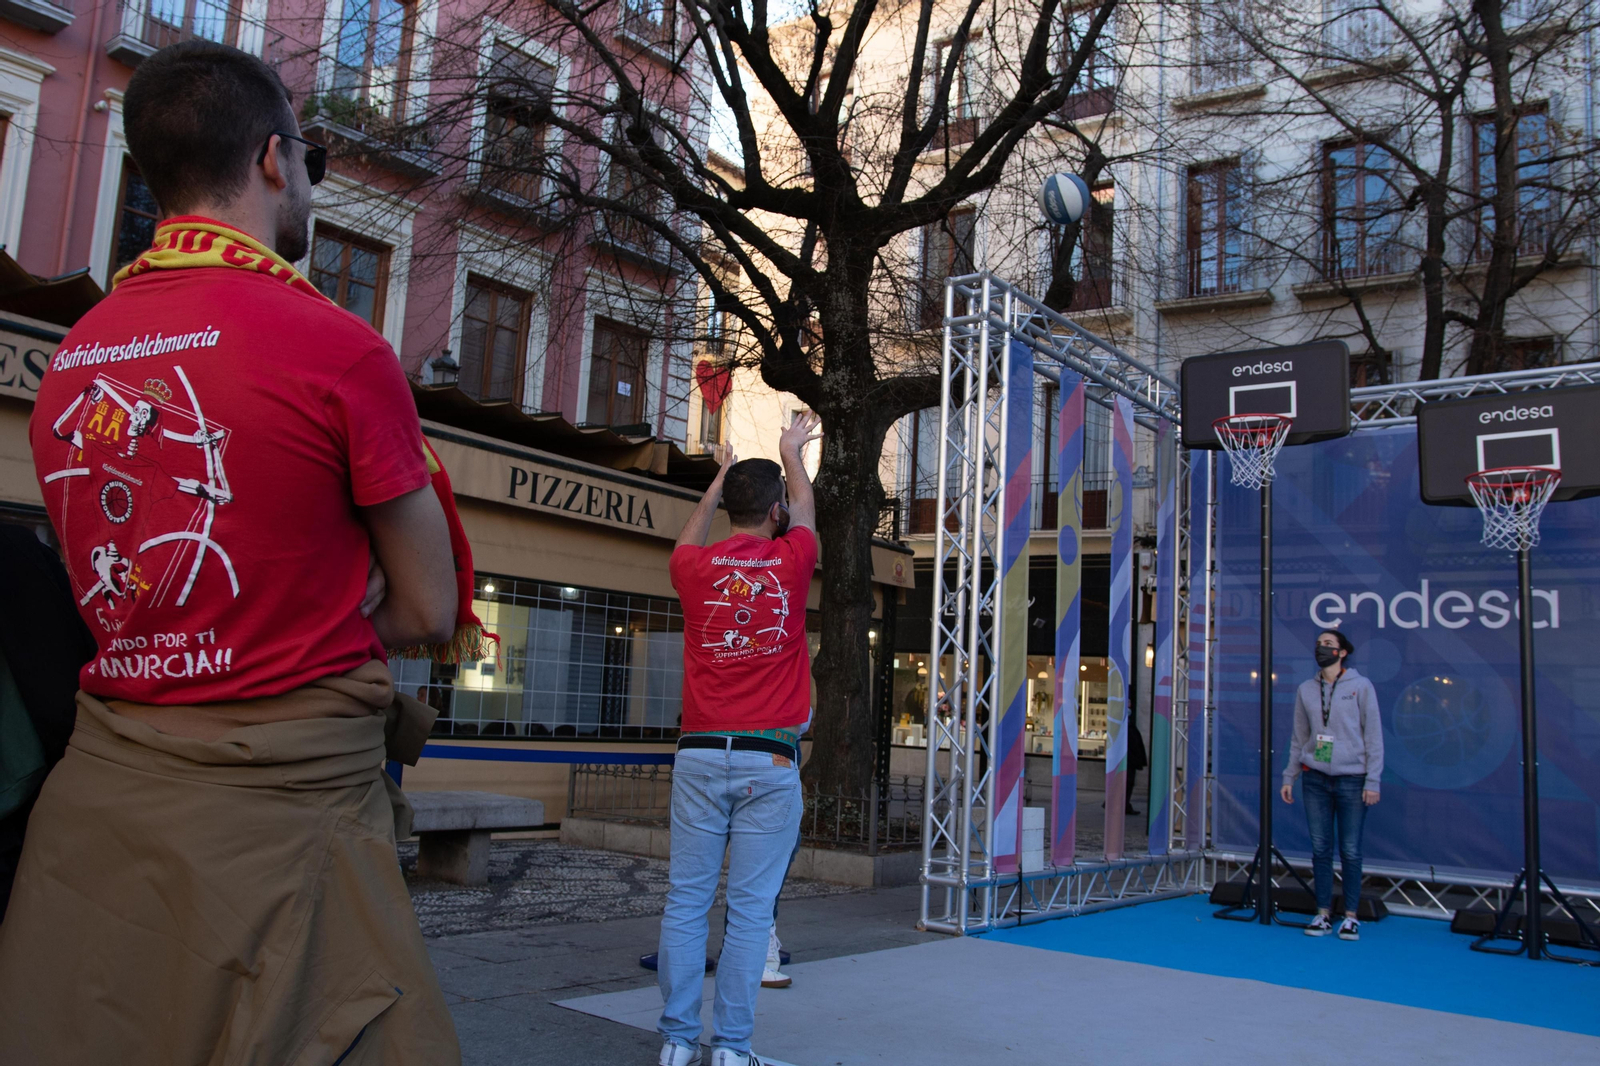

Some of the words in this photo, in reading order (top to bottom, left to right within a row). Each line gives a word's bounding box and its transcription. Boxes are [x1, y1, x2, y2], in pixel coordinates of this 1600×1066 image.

[52, 325, 220, 372] #Sufridoresdelcbmurcia
[1232, 361, 1293, 377] endesa
[1479, 405, 1553, 424] endesa
[507, 465, 655, 530] PIZZERIA
[1309, 578, 1560, 629] endesa
[153, 633, 188, 648] POR
[100, 648, 232, 679] MURCIA!!
